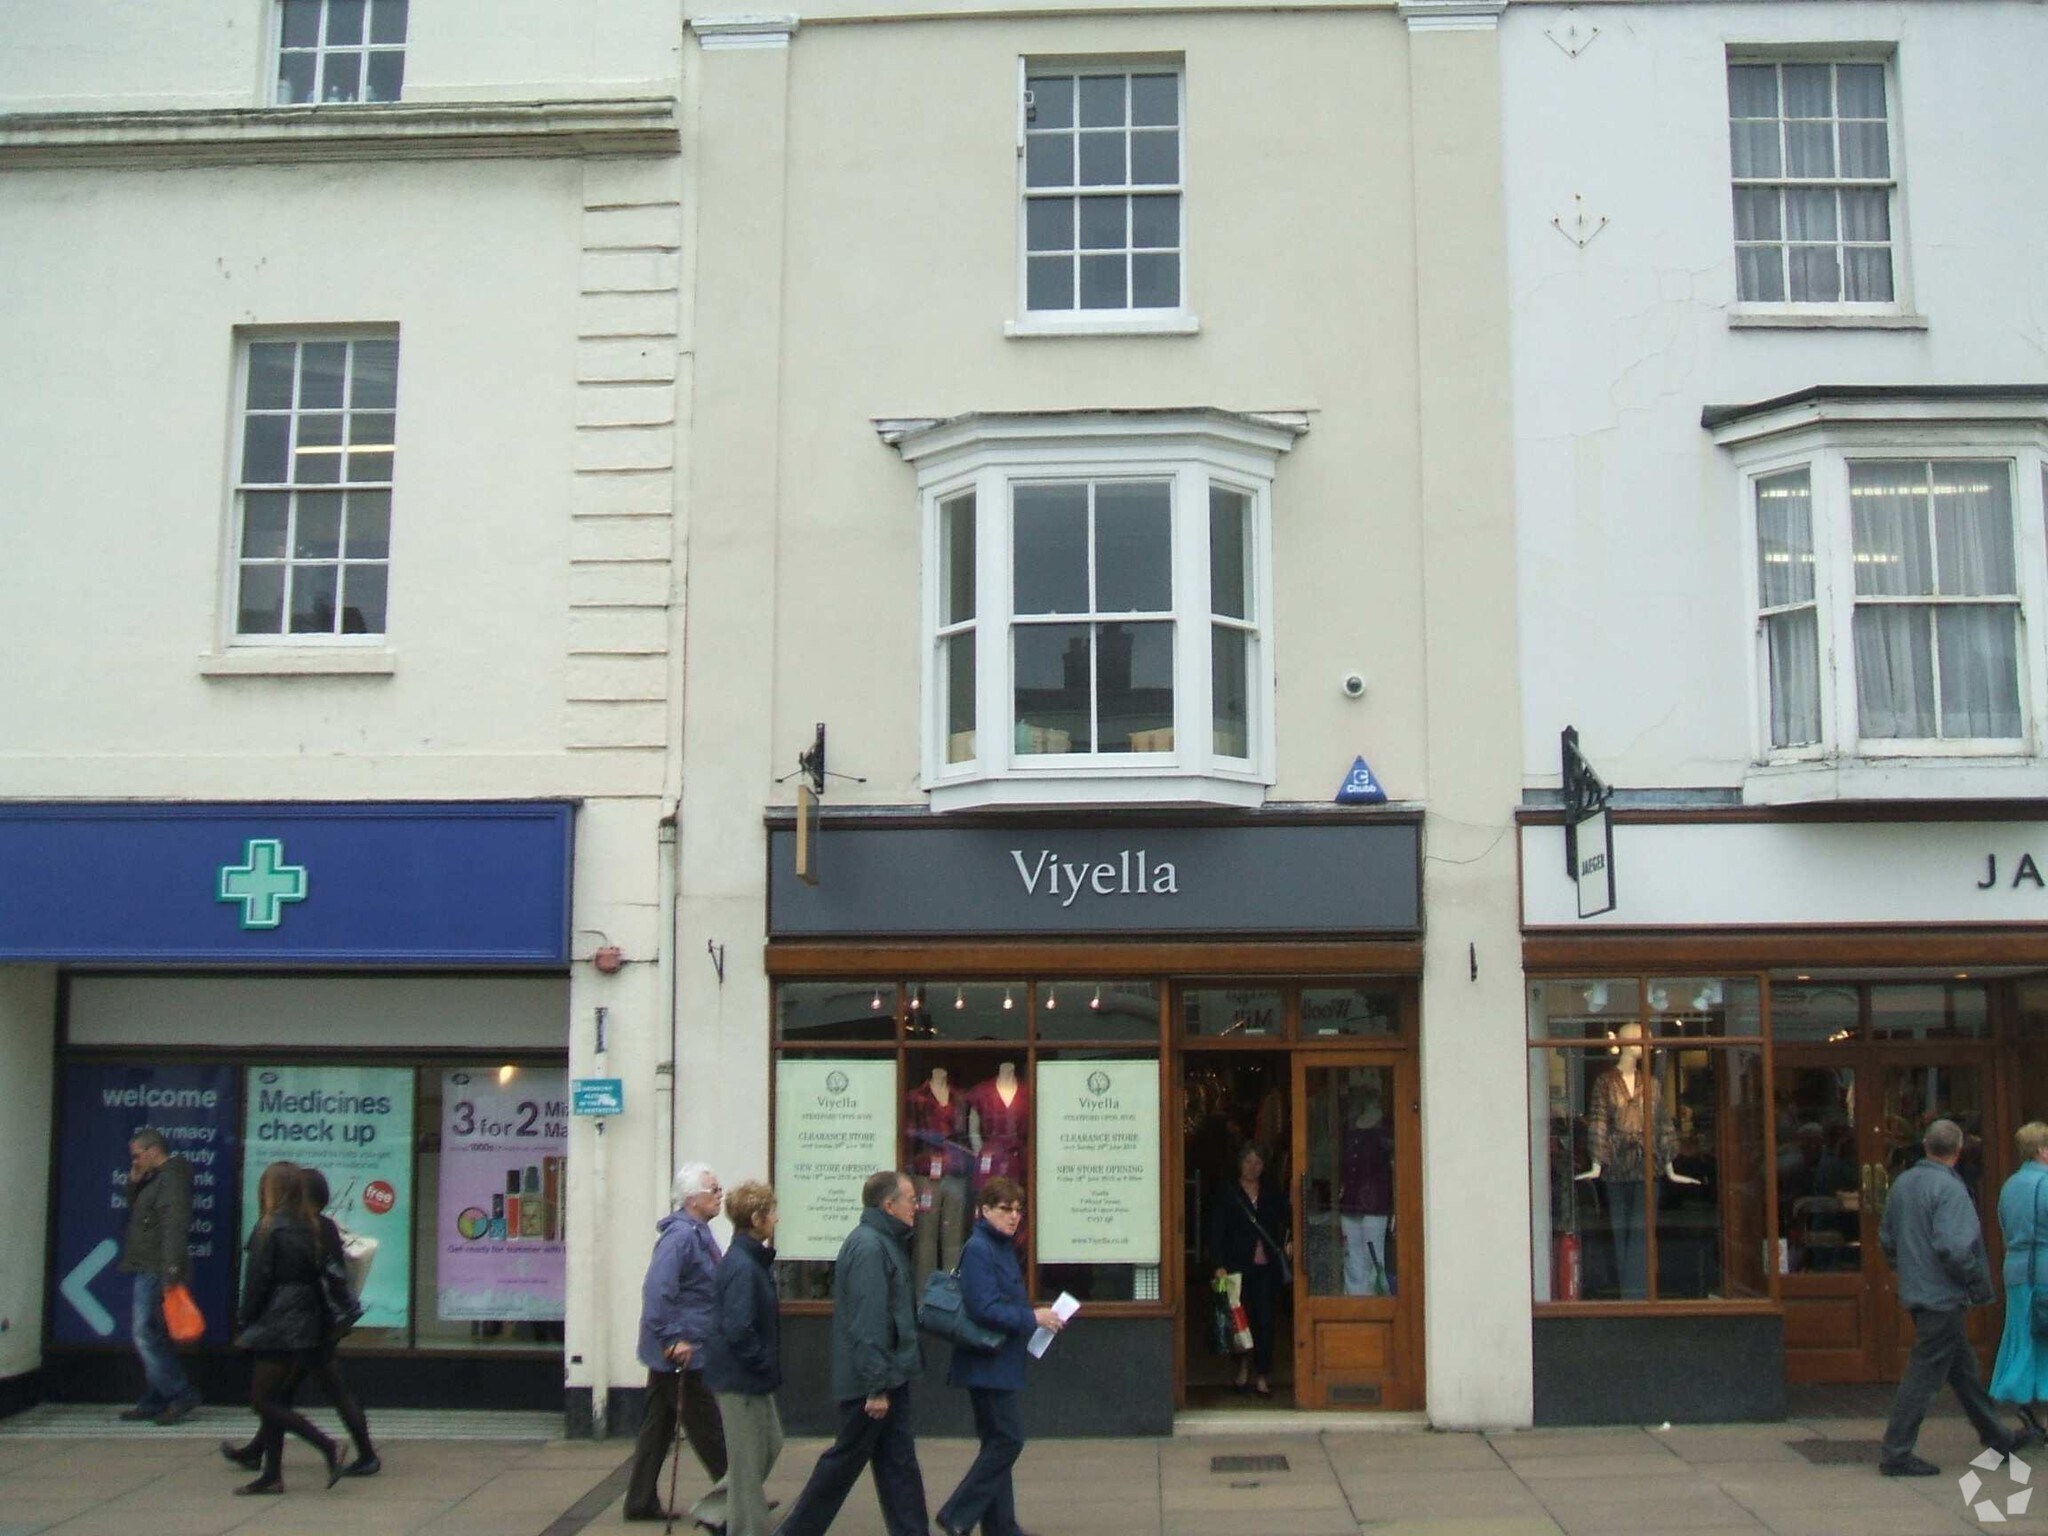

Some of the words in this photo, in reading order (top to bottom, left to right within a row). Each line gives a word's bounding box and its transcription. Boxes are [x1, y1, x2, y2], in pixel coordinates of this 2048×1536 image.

[1346, 784, 1377, 793] Chubb
[1009, 850, 1179, 907] Viyella
[103, 1084, 218, 1107] welcome
[259, 1089, 391, 1115] Medicines
[817, 1096, 856, 1111] Viyella
[1079, 1097, 1120, 1111] Viyella
[453, 1101, 475, 1136] 3
[480, 1118, 512, 1136] for
[516, 1101, 538, 1136] 2
[258, 1119, 334, 1142] check
[342, 1124, 376, 1147] up
[798, 1132, 848, 1141] CLEARANCE
[849, 1132, 875, 1141] STORE
[1060, 1133, 1110, 1142] CLEARANCE
[1112, 1132, 1138, 1142] STORE
[794, 1163, 812, 1172] NEW
[815, 1163, 840, 1172] STORE
[1056, 1164, 1074, 1174] NEW
[1077, 1164, 1104, 1174] STORE
[366, 1185, 393, 1204] free
